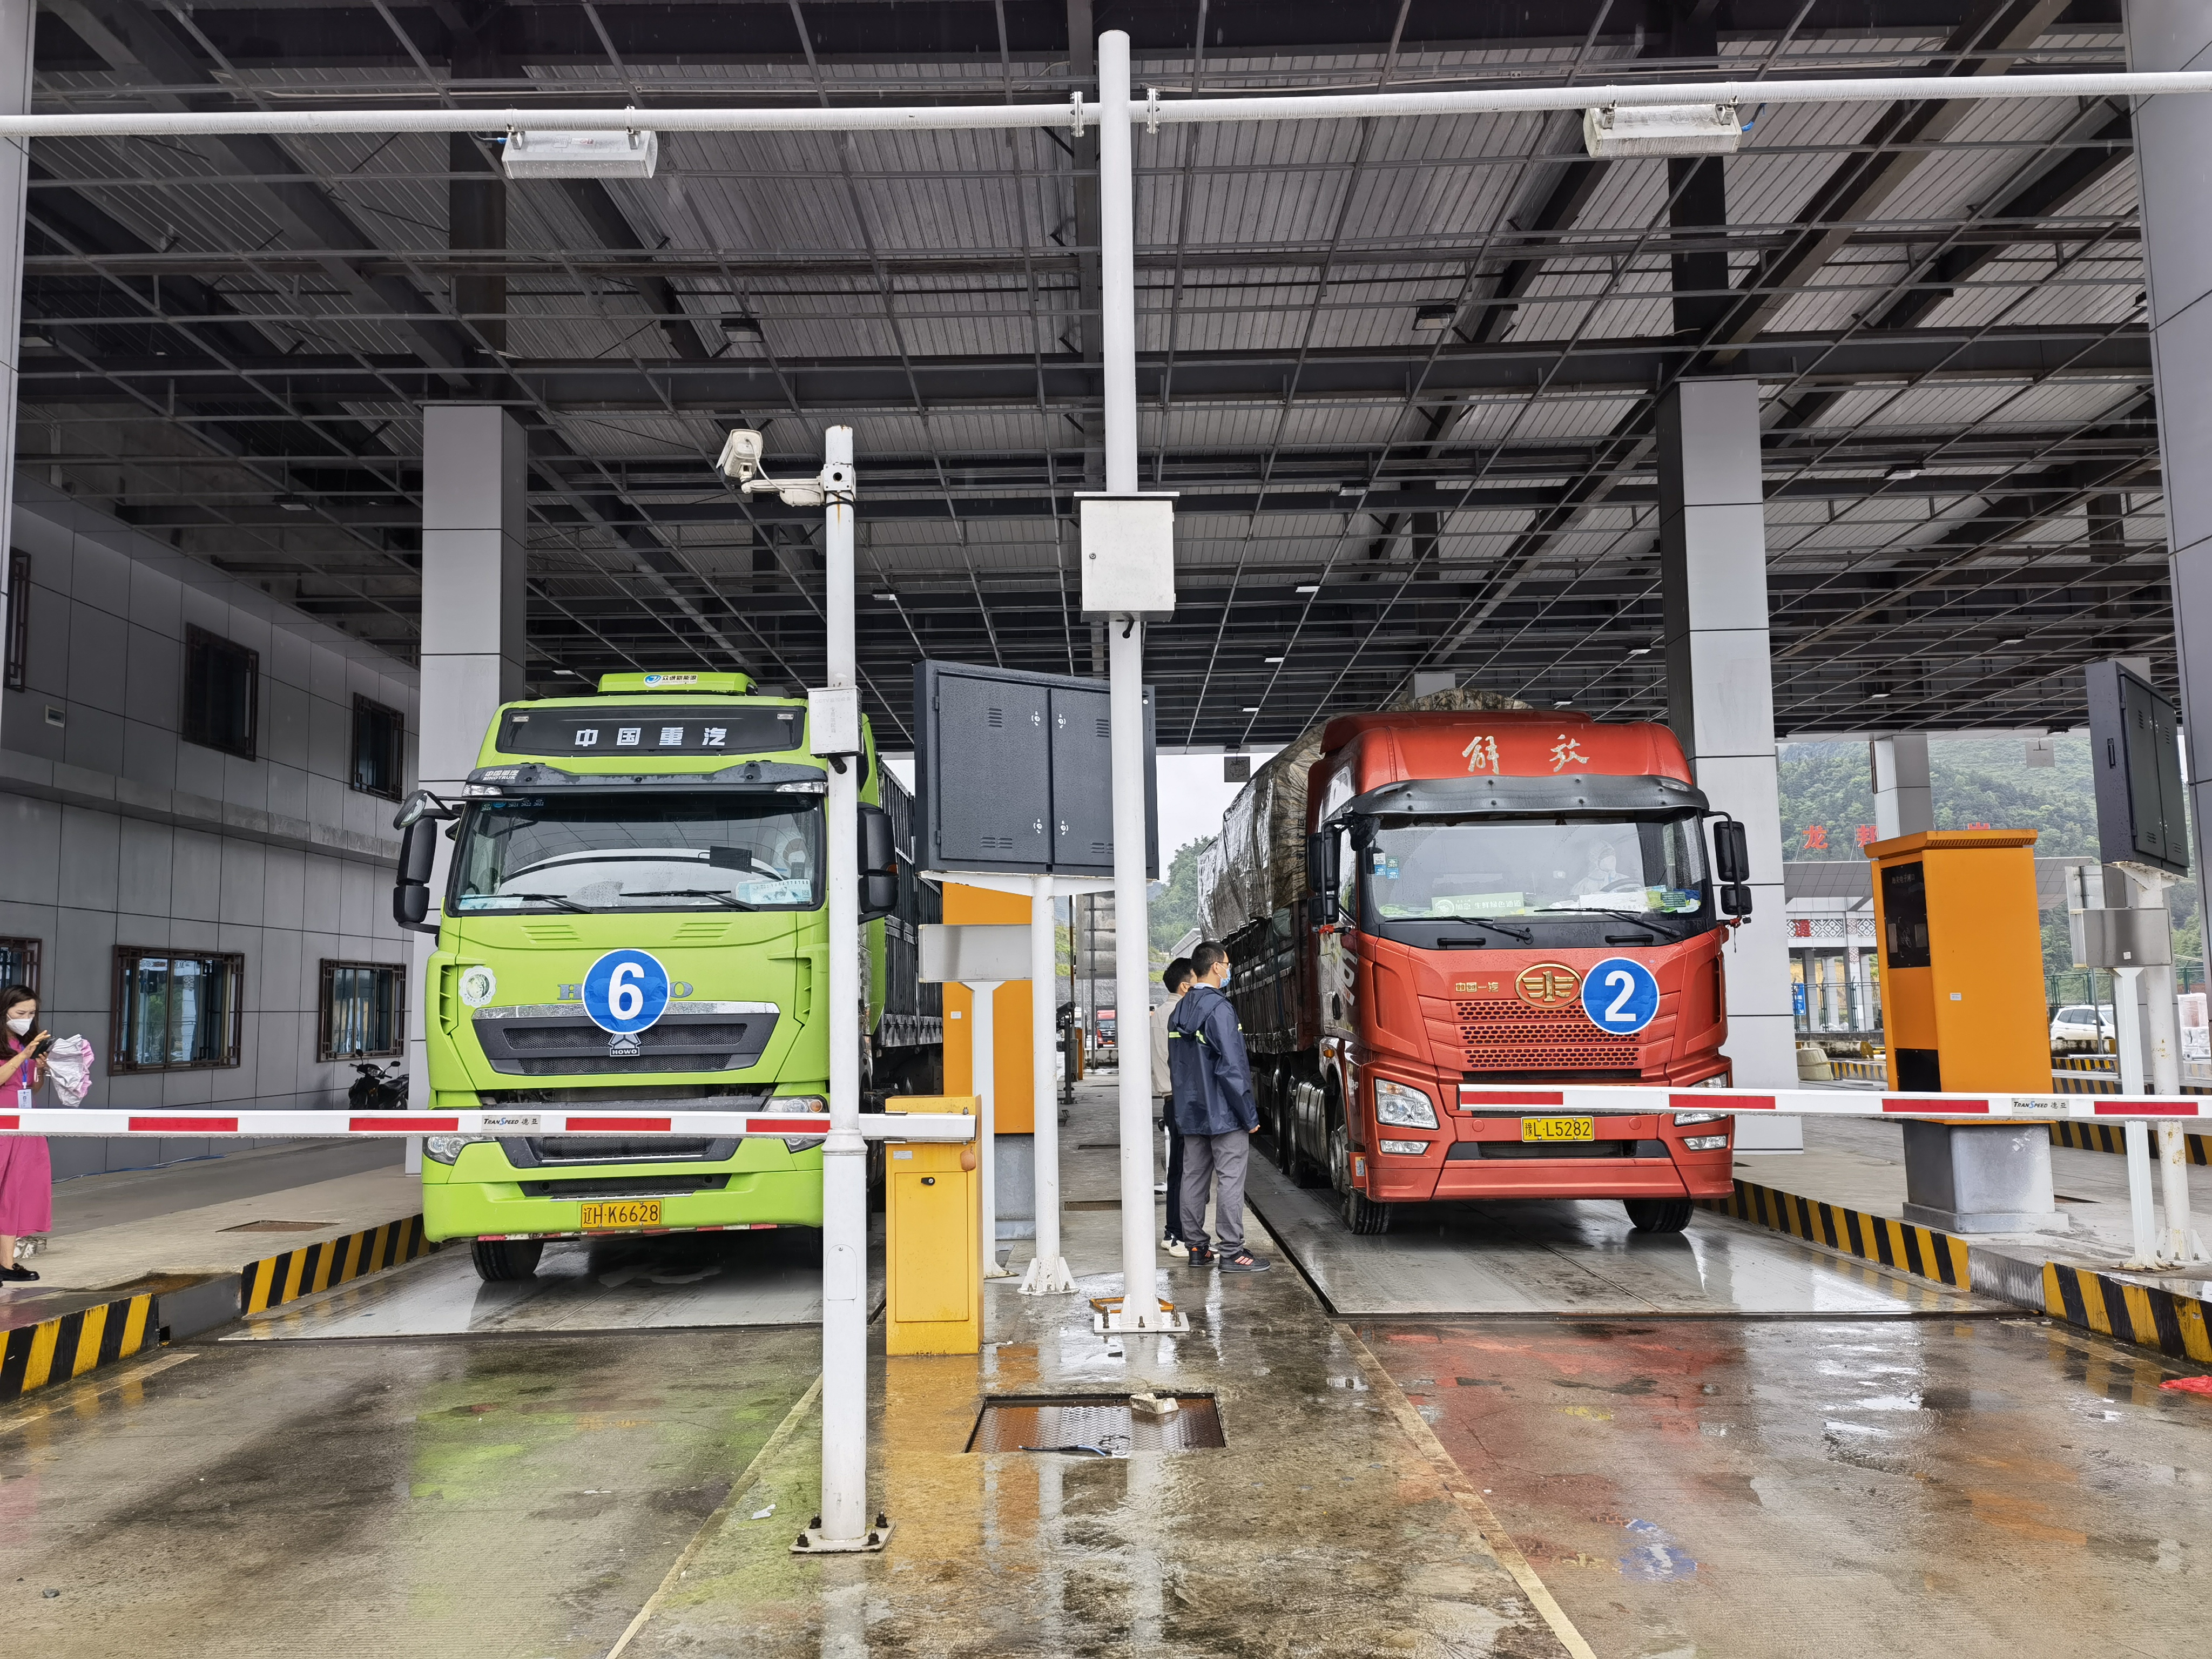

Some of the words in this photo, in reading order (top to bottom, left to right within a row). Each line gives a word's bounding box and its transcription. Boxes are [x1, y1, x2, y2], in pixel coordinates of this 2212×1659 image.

[575, 727, 727, 746] 中国重汽
[1462, 734, 1590, 774] 解放
[608, 962, 645, 1020] 6
[1455, 981, 1499, 993] 中国一汽
[1604, 970, 1636, 1022] 2
